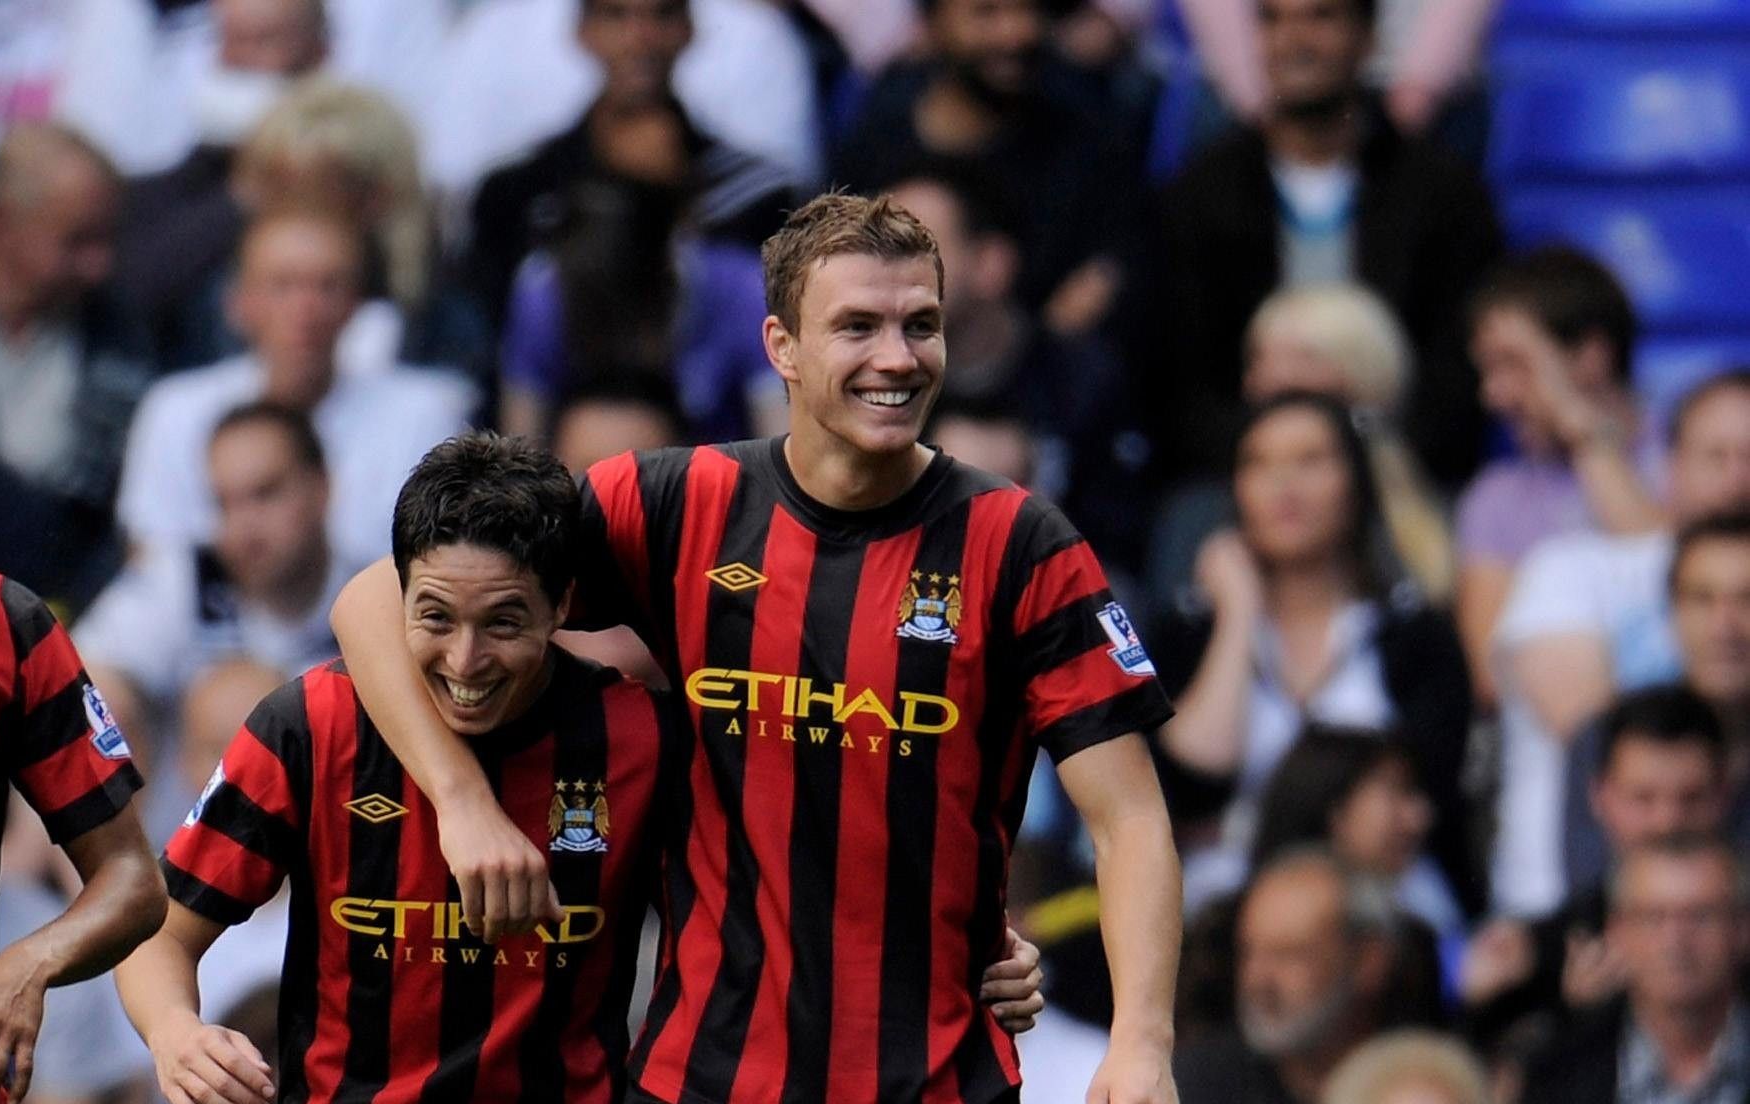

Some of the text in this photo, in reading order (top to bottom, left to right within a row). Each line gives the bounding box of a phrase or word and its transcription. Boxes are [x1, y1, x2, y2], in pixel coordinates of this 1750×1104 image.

[685, 667, 960, 734] ETIHAD
[725, 717, 912, 757] AIRWAYS
[330, 896, 606, 943] ETID
[373, 943, 568, 968] AIRWAYS
